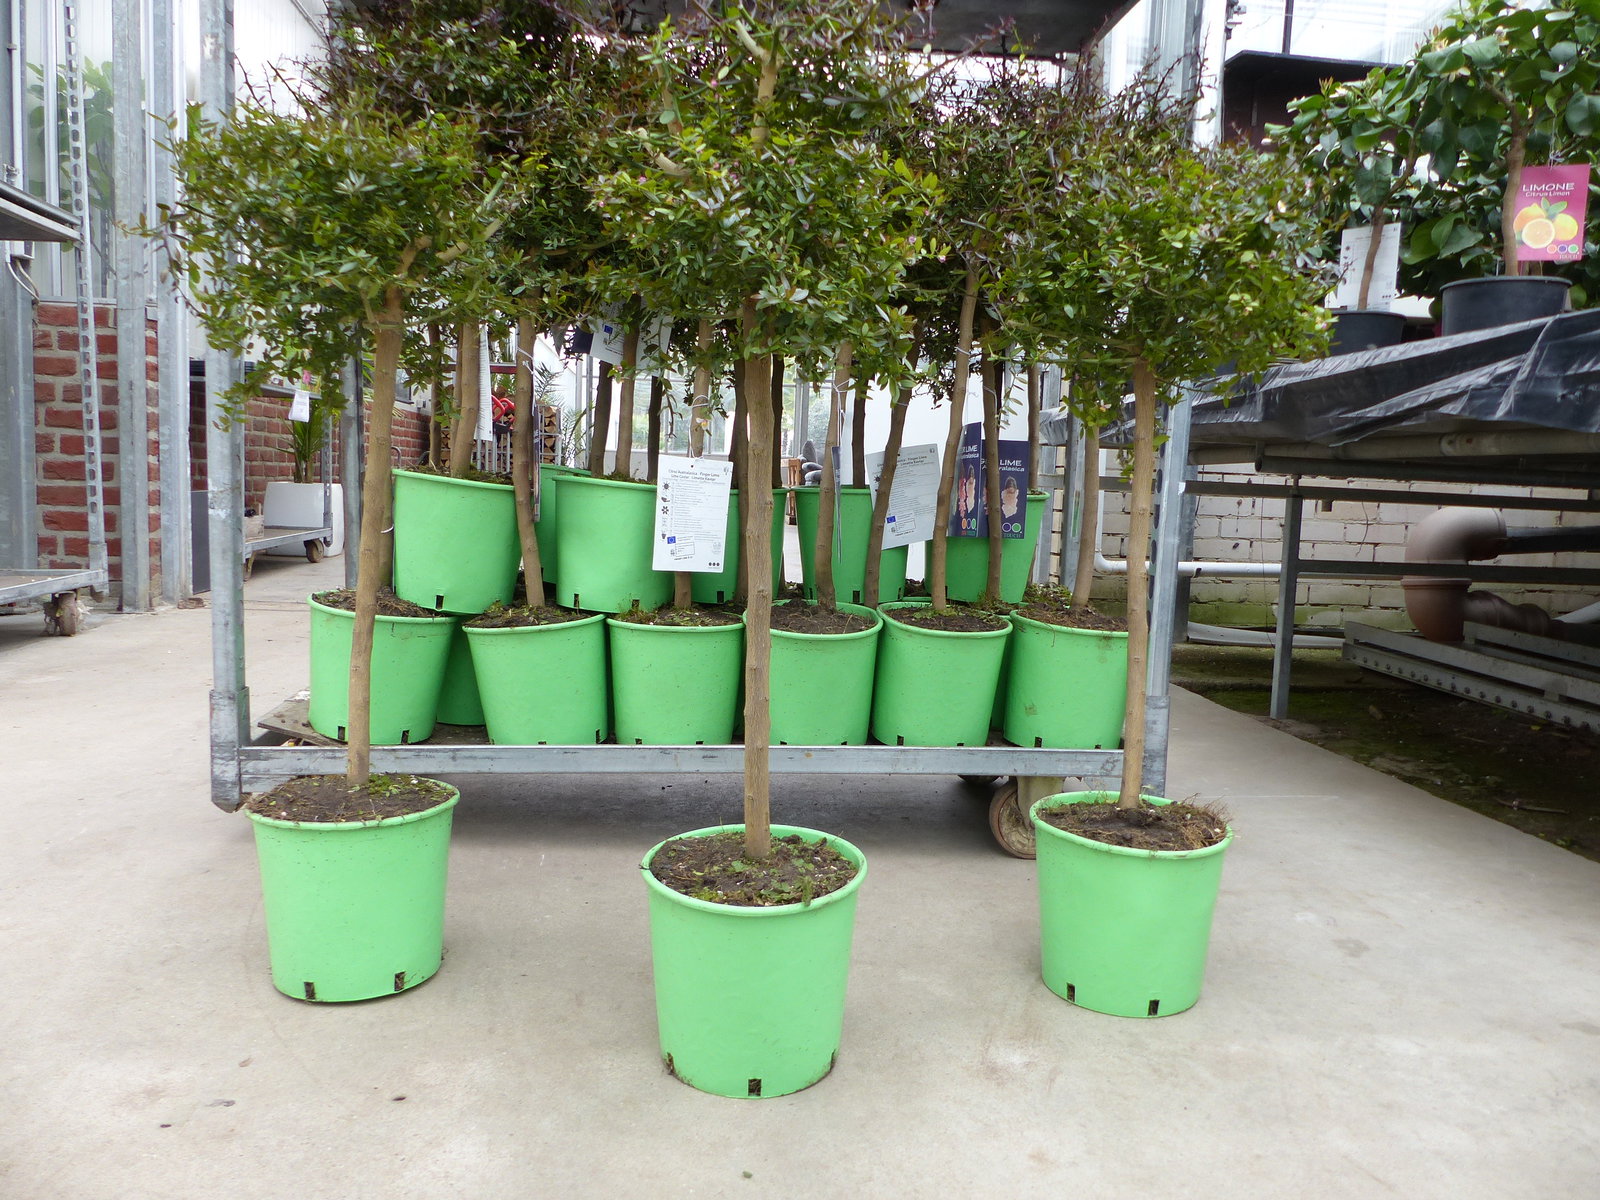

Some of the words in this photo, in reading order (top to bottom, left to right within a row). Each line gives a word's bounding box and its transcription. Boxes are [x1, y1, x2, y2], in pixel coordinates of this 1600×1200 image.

[1522, 183, 1575, 192] LIMONE
[965, 445, 978, 453] LIME
[1000, 459, 1022, 467] LIME
